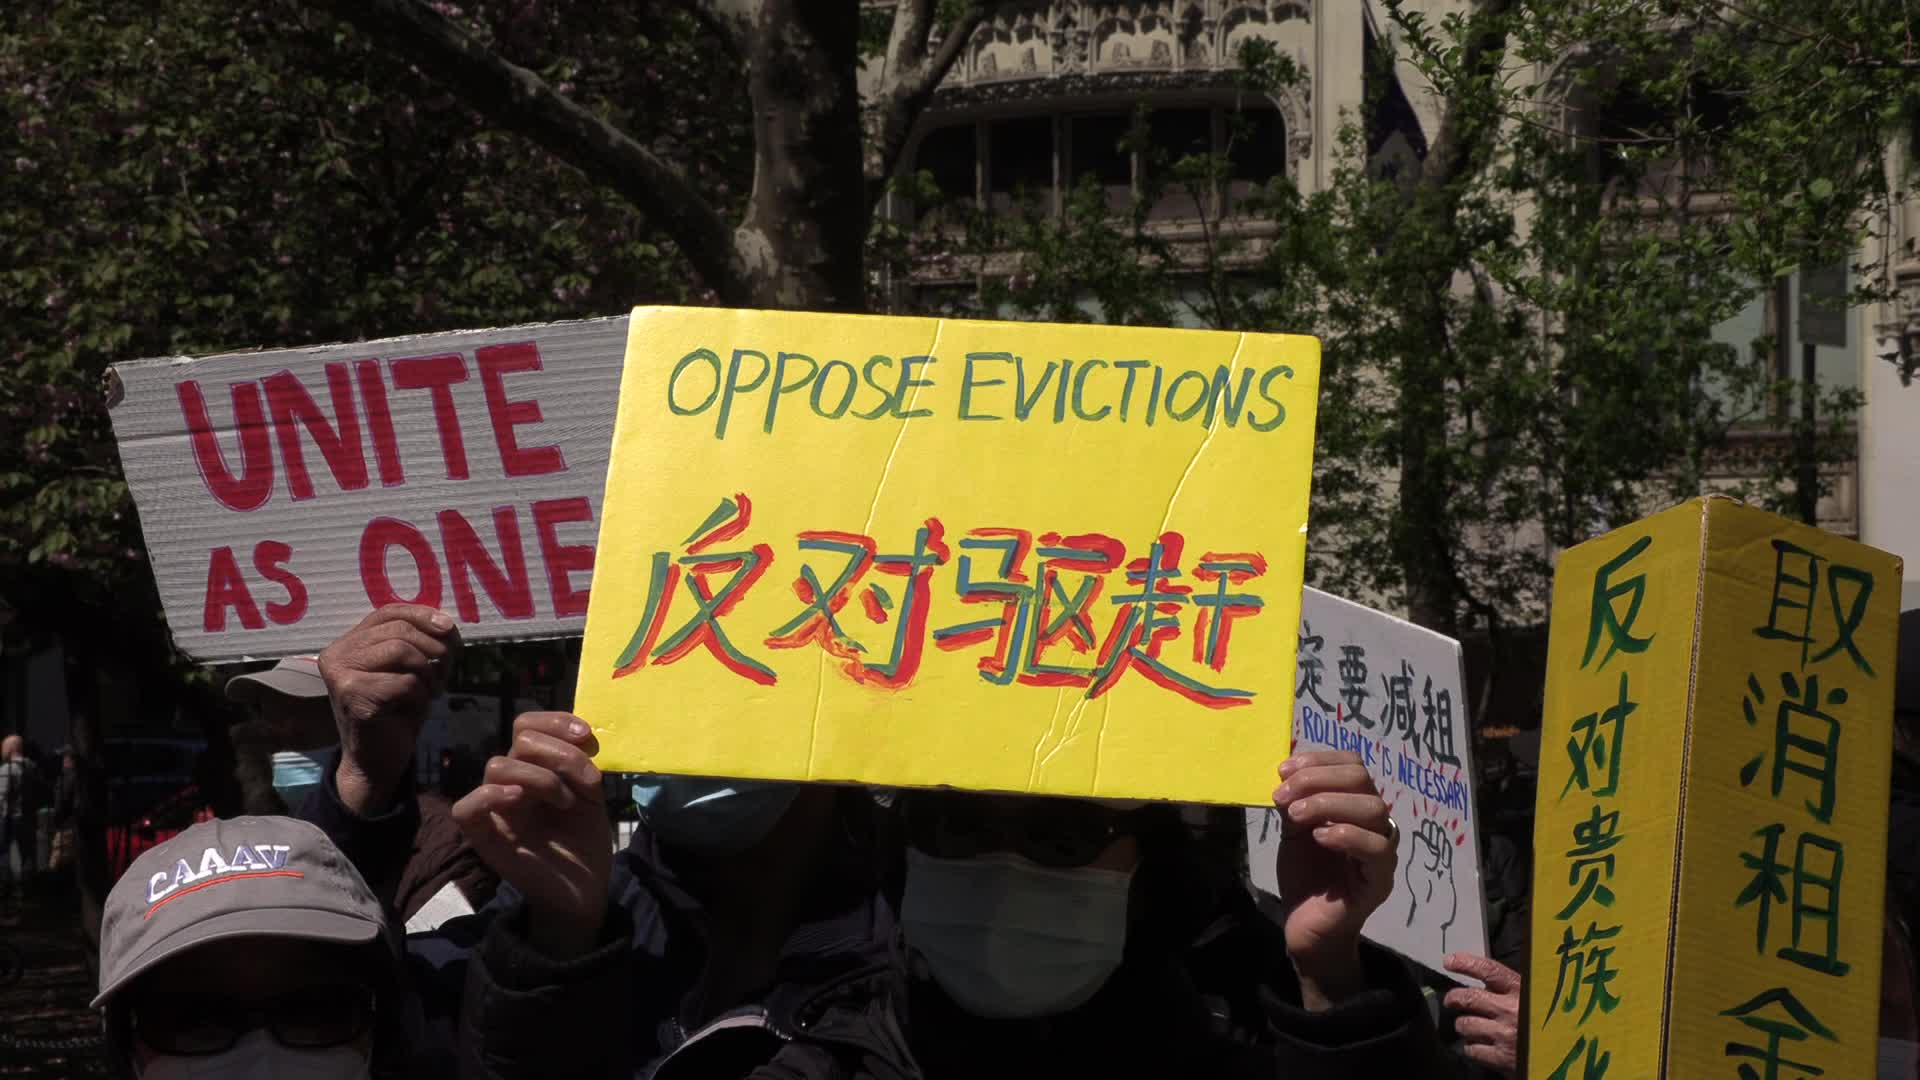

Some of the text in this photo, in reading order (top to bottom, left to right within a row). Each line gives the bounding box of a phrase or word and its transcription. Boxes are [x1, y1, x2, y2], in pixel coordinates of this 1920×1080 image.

[175, 341, 568, 512] UNITE
[667, 348, 1294, 439] OPPOSE EVICTIONS
[203, 497, 595, 632] AS ONE
[612, 492, 1268, 708] 反对驱赶
[1382, 745, 1393, 777] IS
[1398, 751, 1468, 821] NECESSARY
[145, 844, 291, 904] CAAAV
